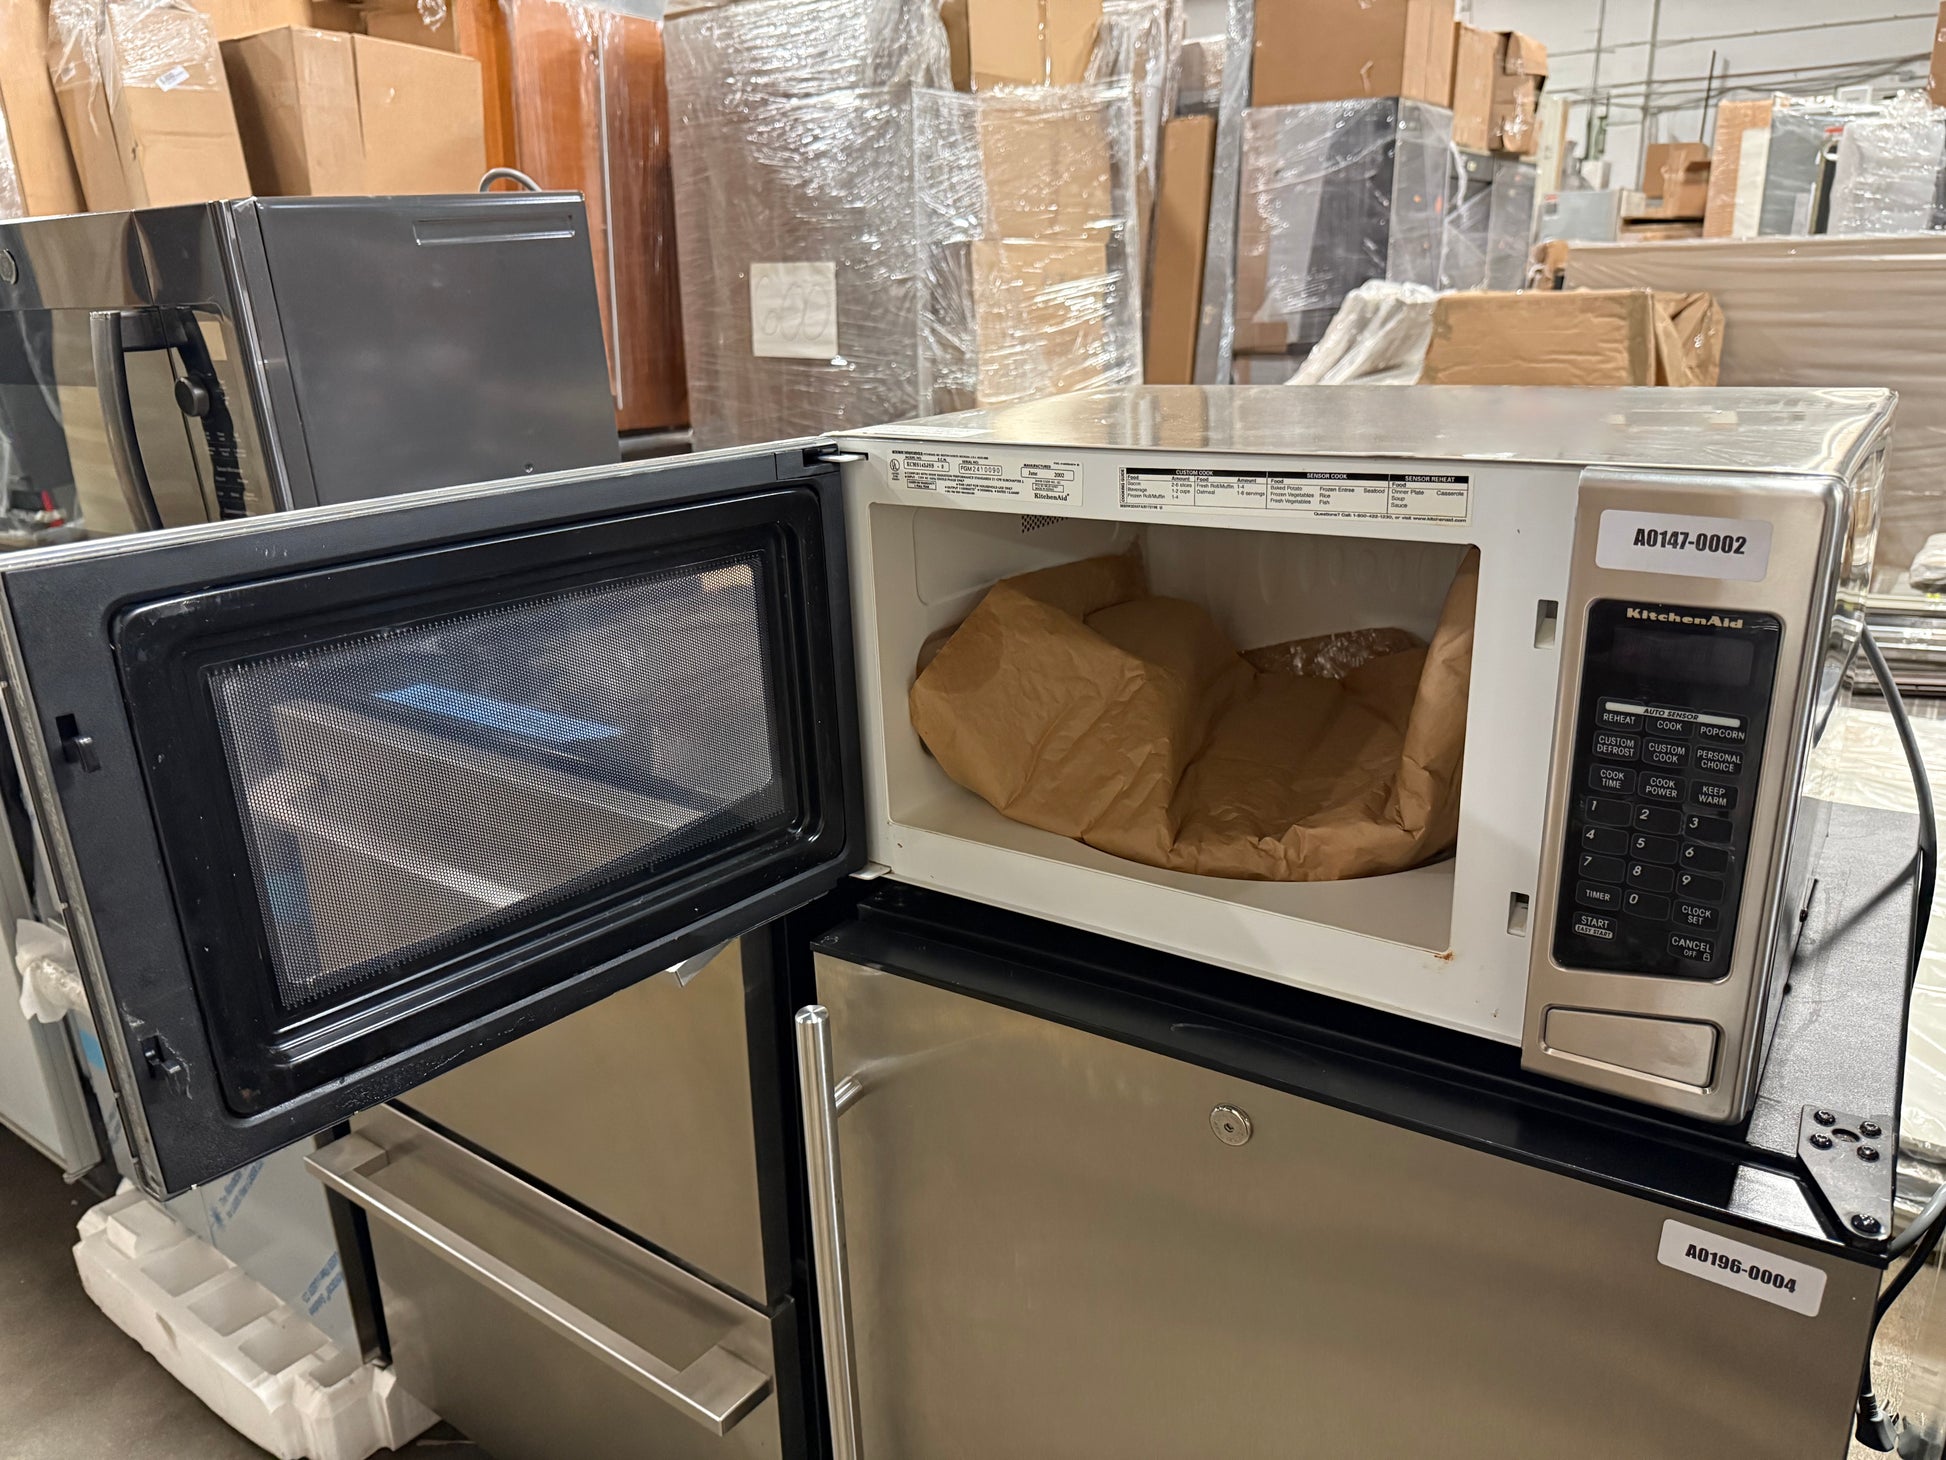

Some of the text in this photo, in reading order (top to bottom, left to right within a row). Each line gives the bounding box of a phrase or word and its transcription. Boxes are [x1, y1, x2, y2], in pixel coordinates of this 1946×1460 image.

[1633, 528, 1748, 554] A0147-0002
[1626, 608, 1744, 628] KitchenAid
[1603, 713, 1635, 725] REHEAT
[1643, 708, 1699, 721] AUTO SENSOR
[1657, 720, 1682, 731] COOK
[1700, 726, 1745, 740] POPCORN
[1599, 736, 1634, 747] CUSTOM
[1597, 744, 1634, 757] DEFROST
[1649, 743, 1685, 755] CUSTOM
[1654, 753, 1678, 764] COOK
[1697, 750, 1741, 764] PERSONAL
[1701, 760, 1734, 772] CHOICE
[1600, 769, 1624, 780] COOK
[1602, 779, 1621, 789] TIME
[1650, 778, 1676, 788] COOK
[1646, 785, 1678, 798] POWER
[1702, 785, 1726, 796] KEEP
[1699, 794, 1727, 806] WARM
[1591, 801, 1597, 811] 1
[1640, 809, 1649, 820] 2
[1689, 817, 1699, 828] 3
[1586, 829, 1596, 839] 4
[1636, 838, 1646, 848] 5
[1685, 847, 1694, 857] 6
[1583, 856, 1592, 866] 7
[1632, 866, 1642, 876] 8
[1682, 875, 1692, 885] 9
[1585, 889, 1610, 901] TIMER
[1629, 894, 1638, 904] 0
[1682, 905, 1711, 918] CLOCK
[1581, 916, 1609, 929] START
[1688, 916, 1703, 926] SET
[1576, 925, 1611, 938] EASY START
[1672, 937, 1711, 952] CANCEL
[1685, 1244, 1797, 1293] A0196-0004
